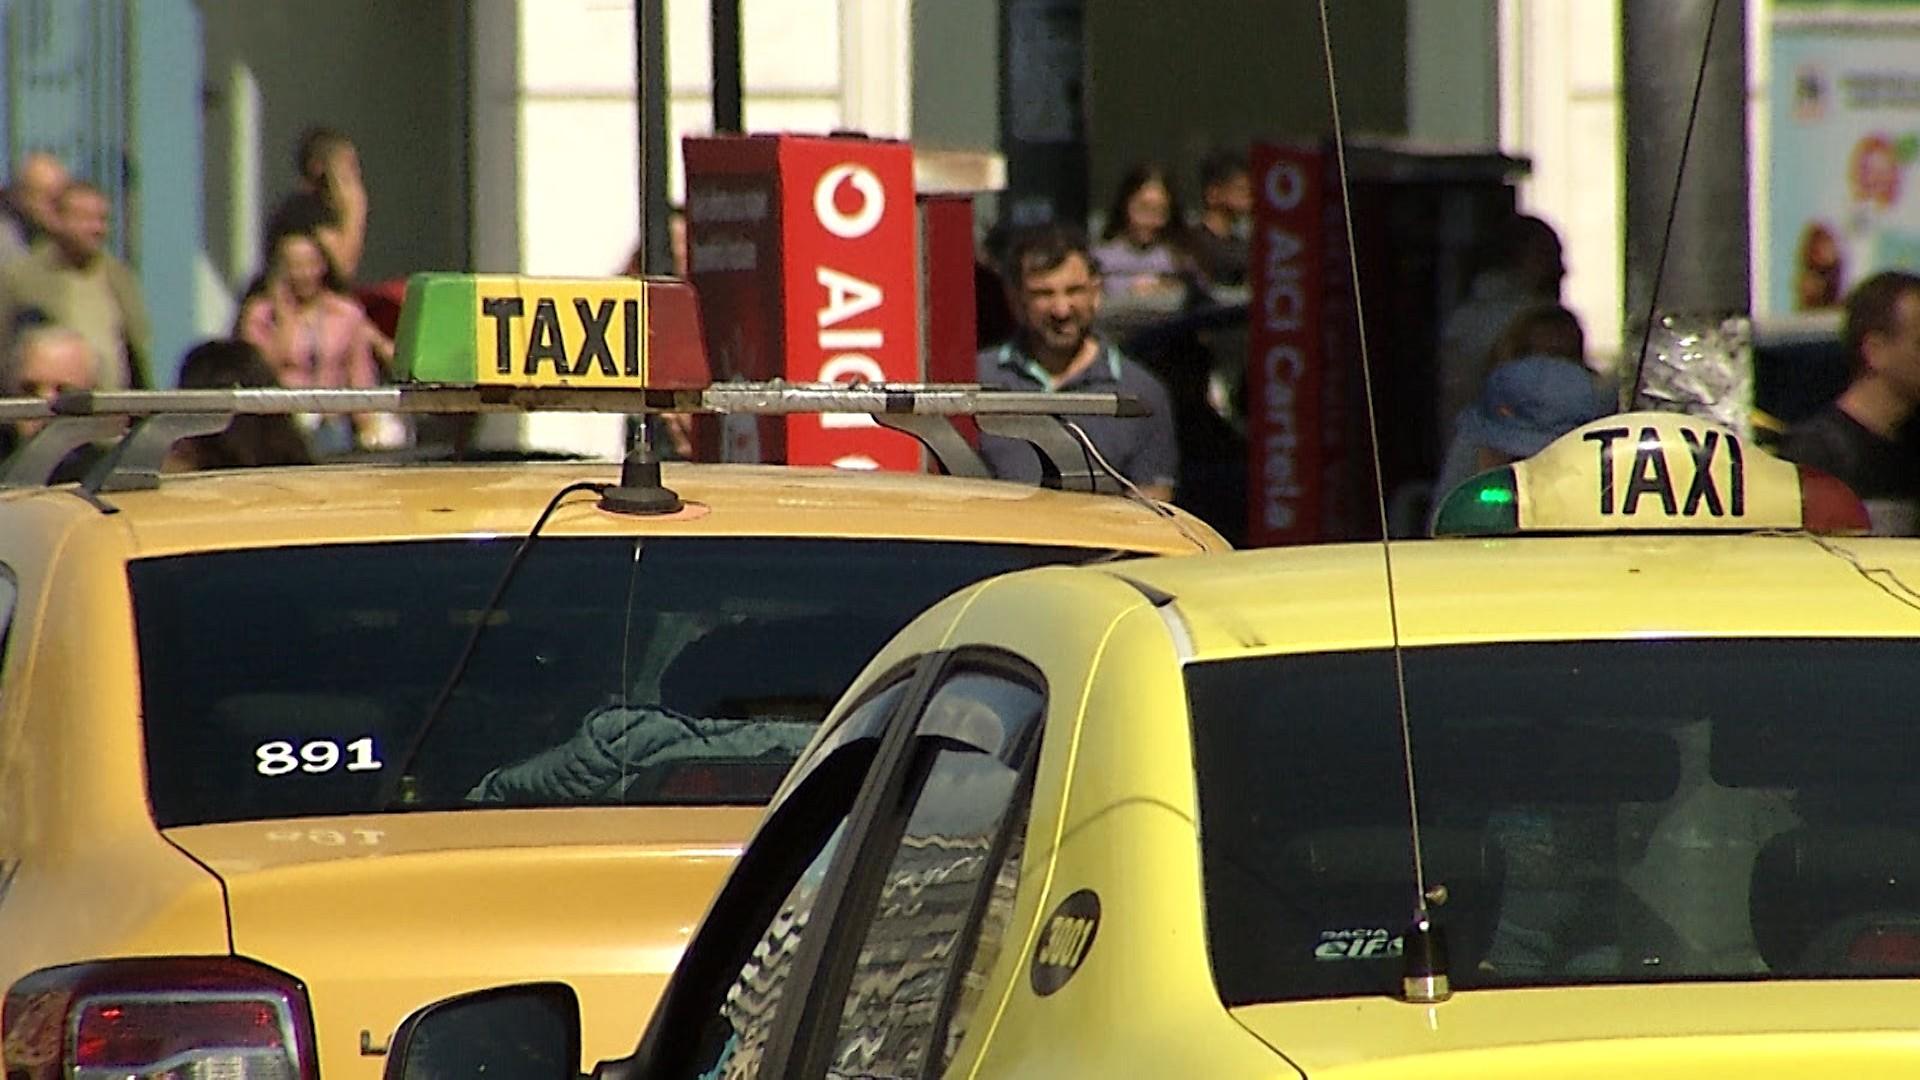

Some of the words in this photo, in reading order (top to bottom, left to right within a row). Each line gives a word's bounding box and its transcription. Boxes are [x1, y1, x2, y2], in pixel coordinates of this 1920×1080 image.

[482, 297, 639, 376] TAXI
[1583, 427, 1744, 516] TAXI
[256, 738, 382, 776] 891
[1039, 915, 1095, 968] 3001
